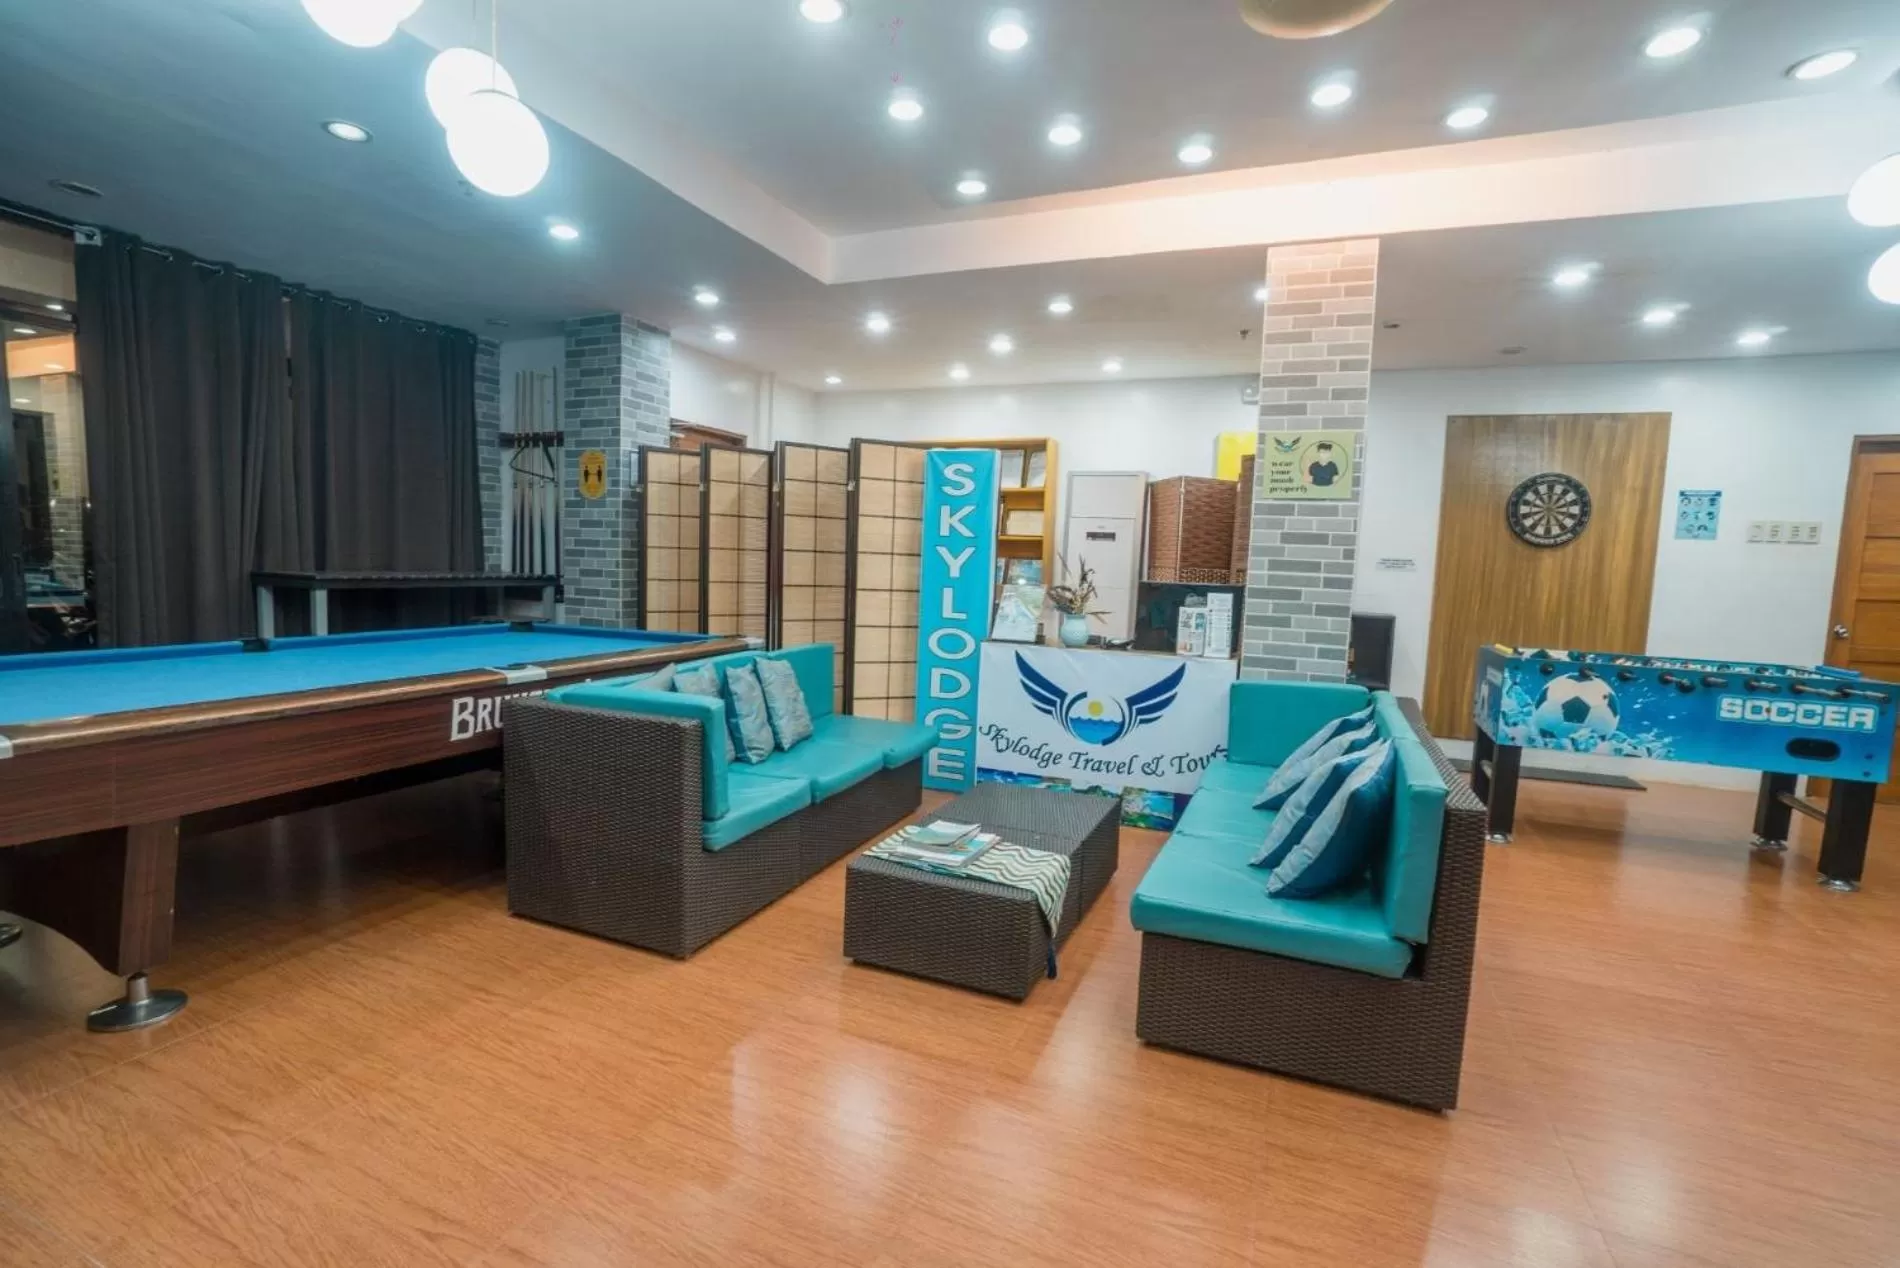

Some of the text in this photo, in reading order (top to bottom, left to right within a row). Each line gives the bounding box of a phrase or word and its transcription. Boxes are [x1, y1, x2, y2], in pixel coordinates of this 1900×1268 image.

[924, 463, 977, 781] SKYLODGE
[1718, 697, 1876, 731] SOCCER
[979, 723, 1063, 769] Skylodge
[1068, 751, 1139, 775] Travel
[1140, 754, 1165, 777] &
